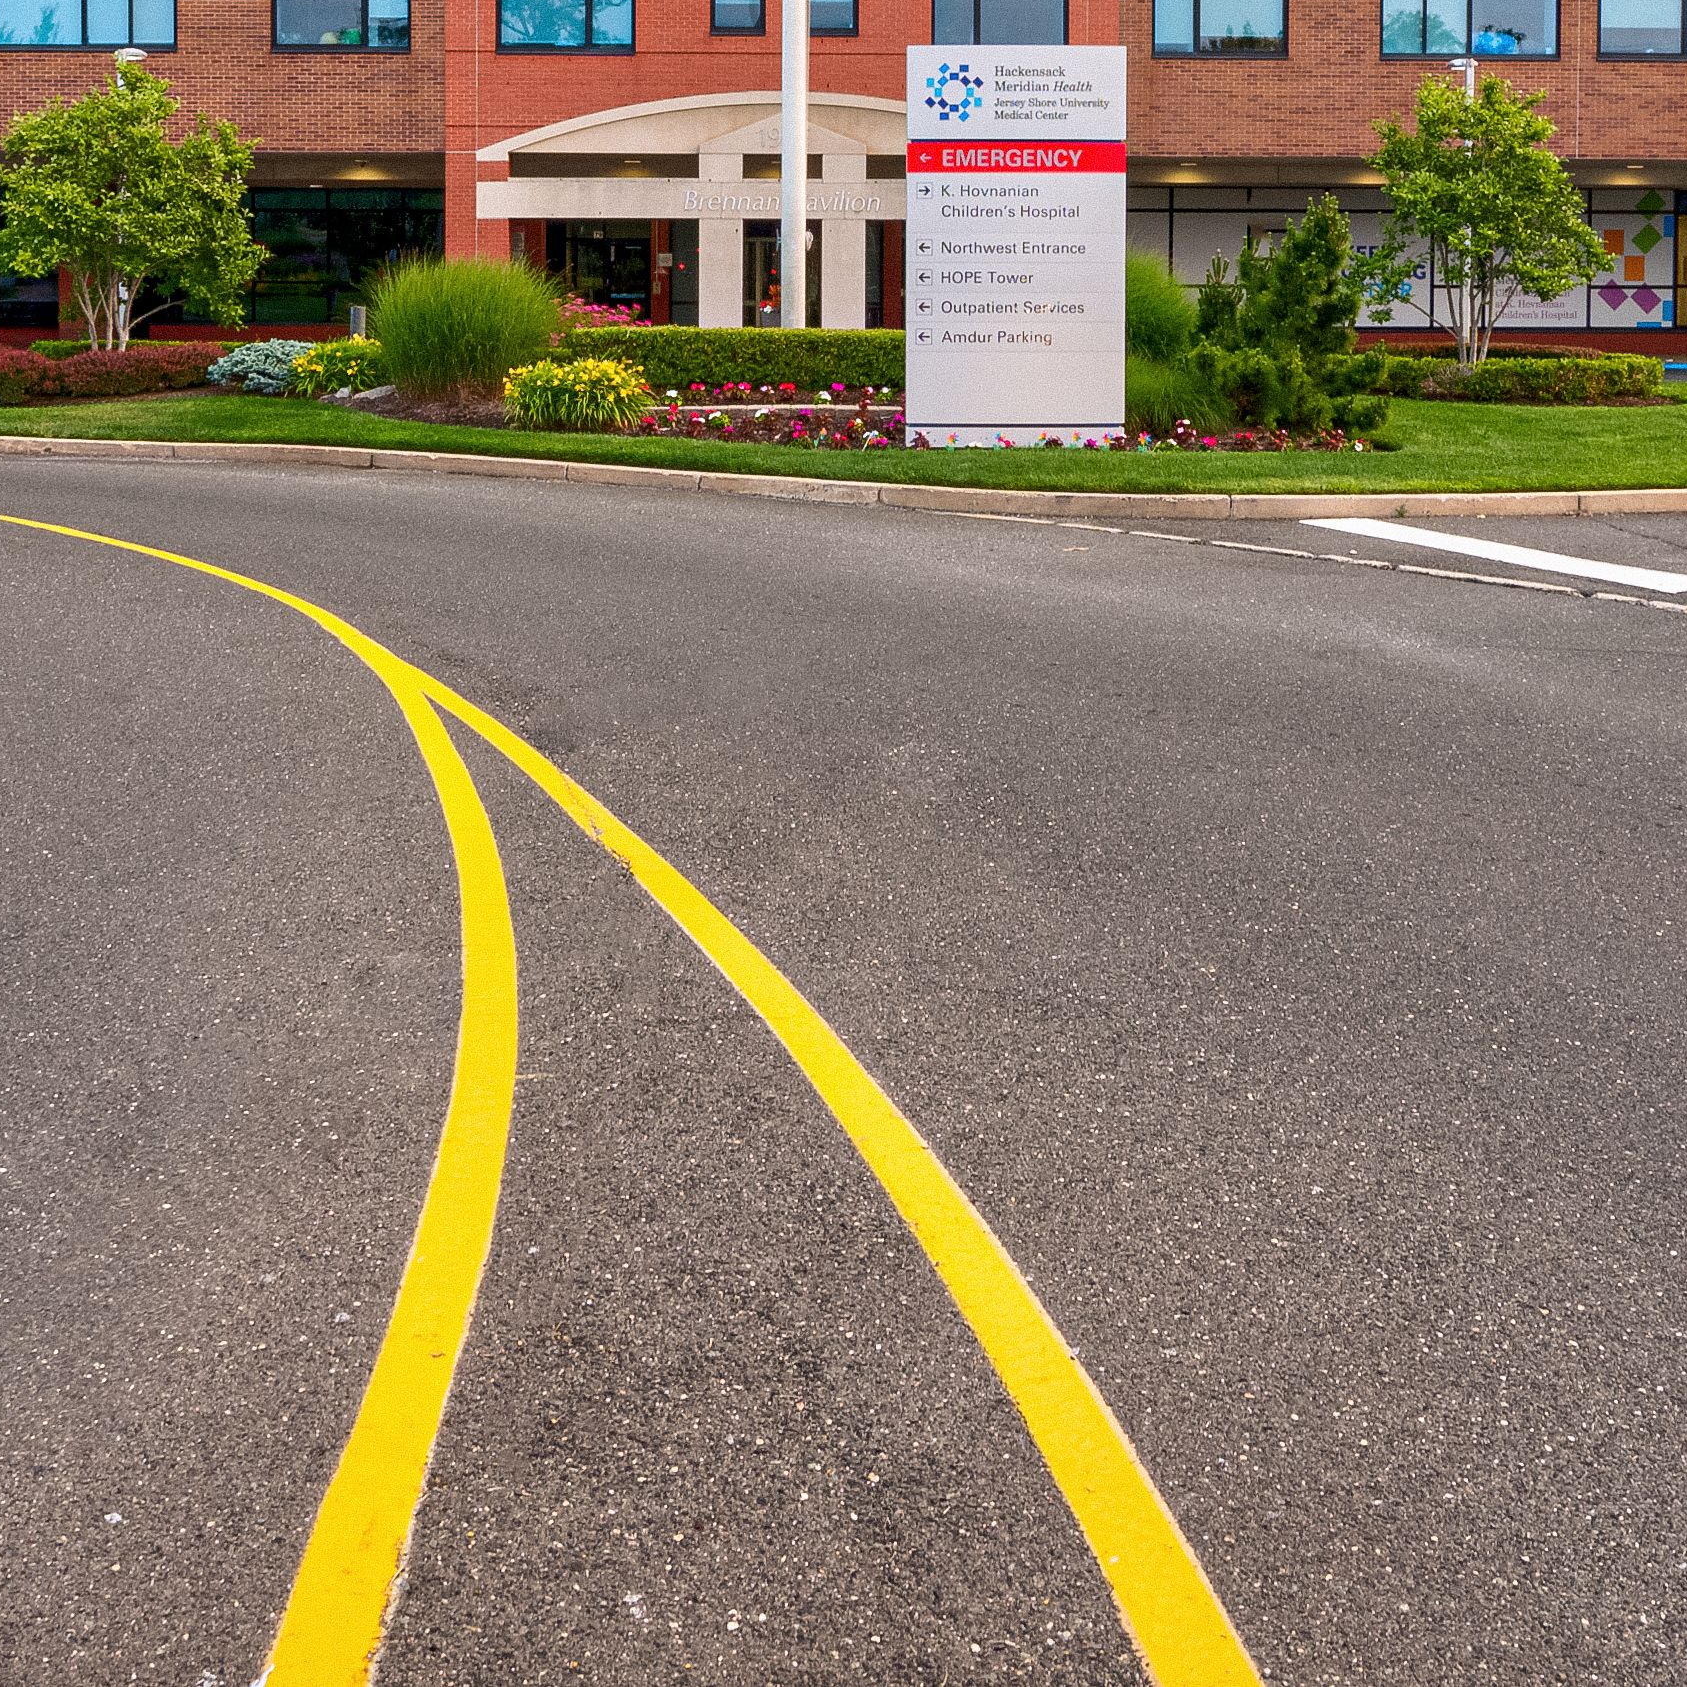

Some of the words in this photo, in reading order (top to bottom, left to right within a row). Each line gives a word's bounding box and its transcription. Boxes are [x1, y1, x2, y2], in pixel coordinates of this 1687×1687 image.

[994, 65, 1066, 78] Hackensack
[994, 81, 1050, 92] Meridian
[1053, 81, 1092, 92] Health
[994, 97, 1026, 110] Jersey
[1028, 97, 1058, 109] Shore
[1060, 97, 1110, 110] University
[994, 110, 1033, 120] Medical
[1035, 110, 1069, 120] Center
[942, 148, 1083, 168] EMERGENCY
[941, 185, 956, 197] K.
[960, 185, 1039, 198] Hovnanian
[684, 190, 780, 211] Brennan
[804, 190, 881, 212] avilion
[941, 204, 1015, 219] Children's
[1020, 204, 1080, 221] Hospital
[941, 242, 1017, 255] Northwest
[1022, 242, 1086, 255] Entrance
[941, 271, 983, 284] HOPE
[988, 271, 1034, 284] Tower
[941, 301, 1018, 316] Outpatient
[1023, 301, 1085, 314] Services
[1541, 311, 1578, 321] Hospital
[941, 330, 992, 343] Amdur
[997, 330, 1052, 346] Parking
